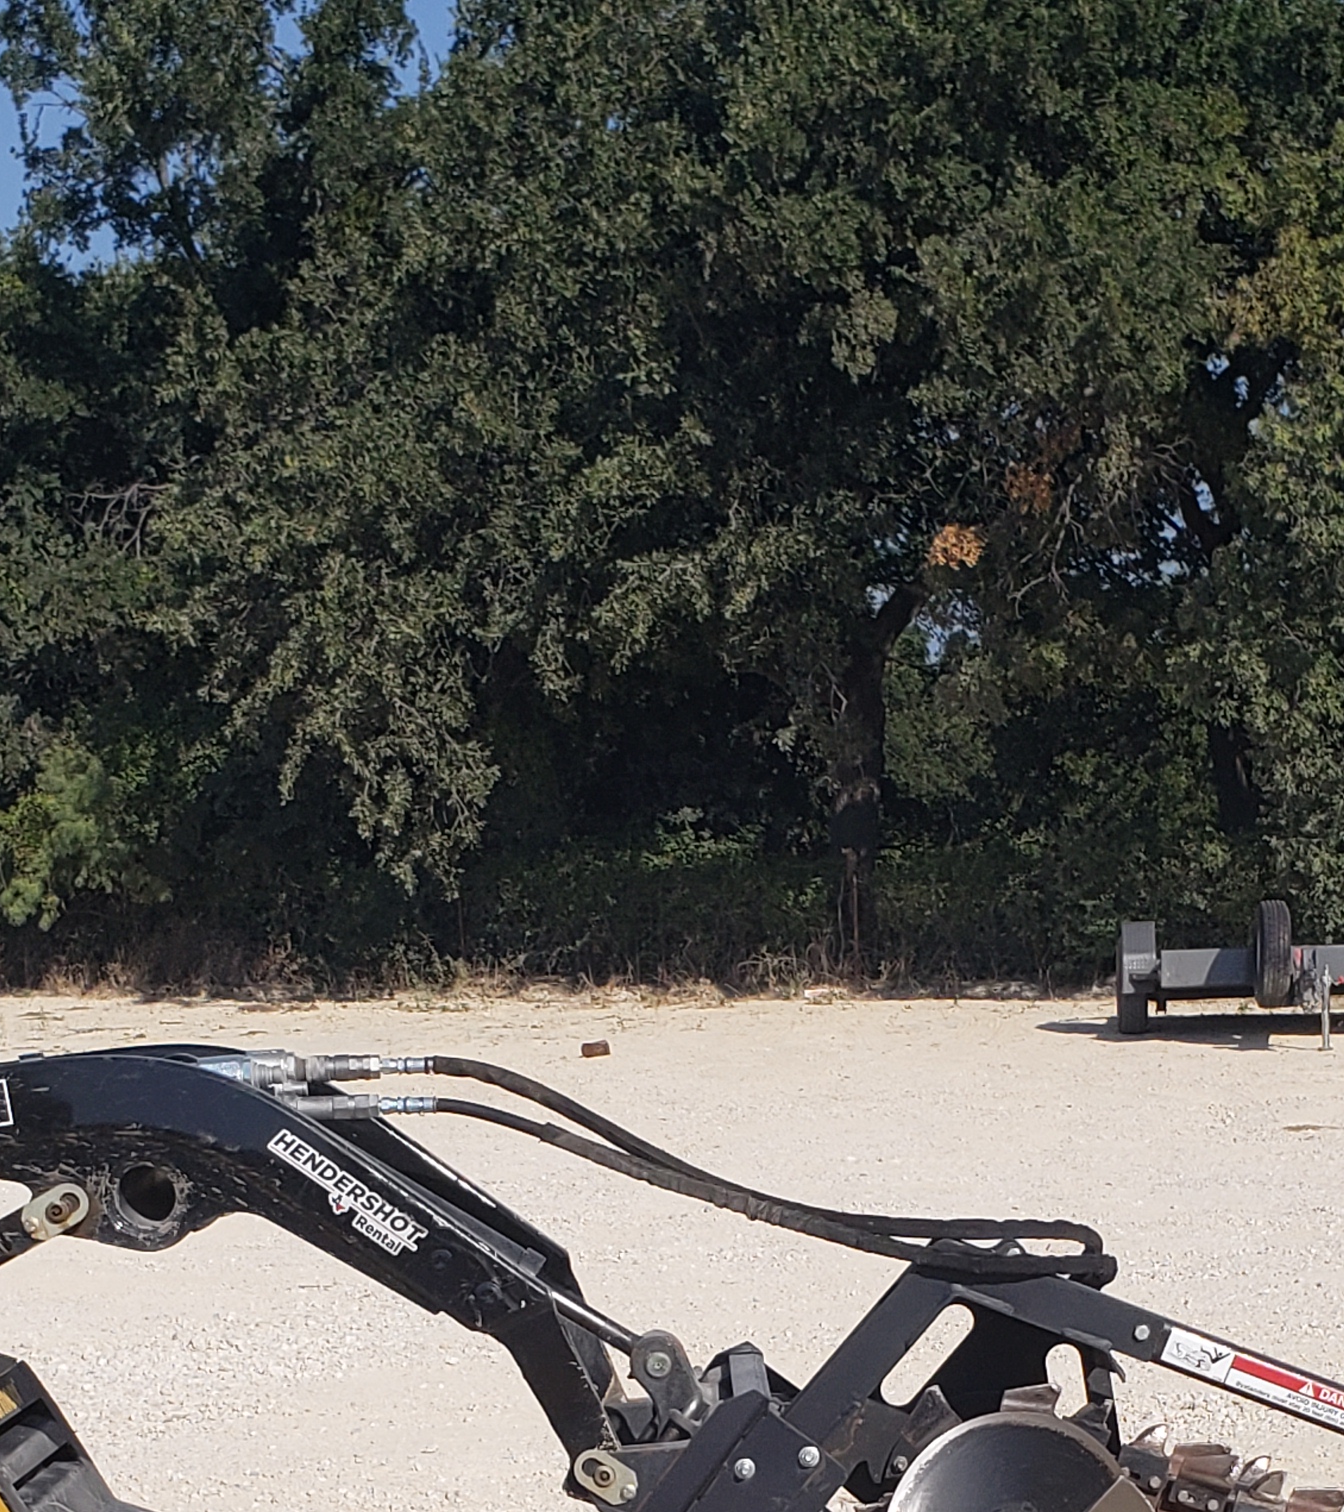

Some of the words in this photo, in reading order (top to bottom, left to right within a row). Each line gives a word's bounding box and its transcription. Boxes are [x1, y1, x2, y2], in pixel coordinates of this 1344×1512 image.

[272, 1131, 427, 1243] HENDERSHOT
[355, 1215, 402, 1253] Rental
[1287, 1393, 1310, 1405] AVOID
[1311, 1401, 1339, 1416] INJURY
